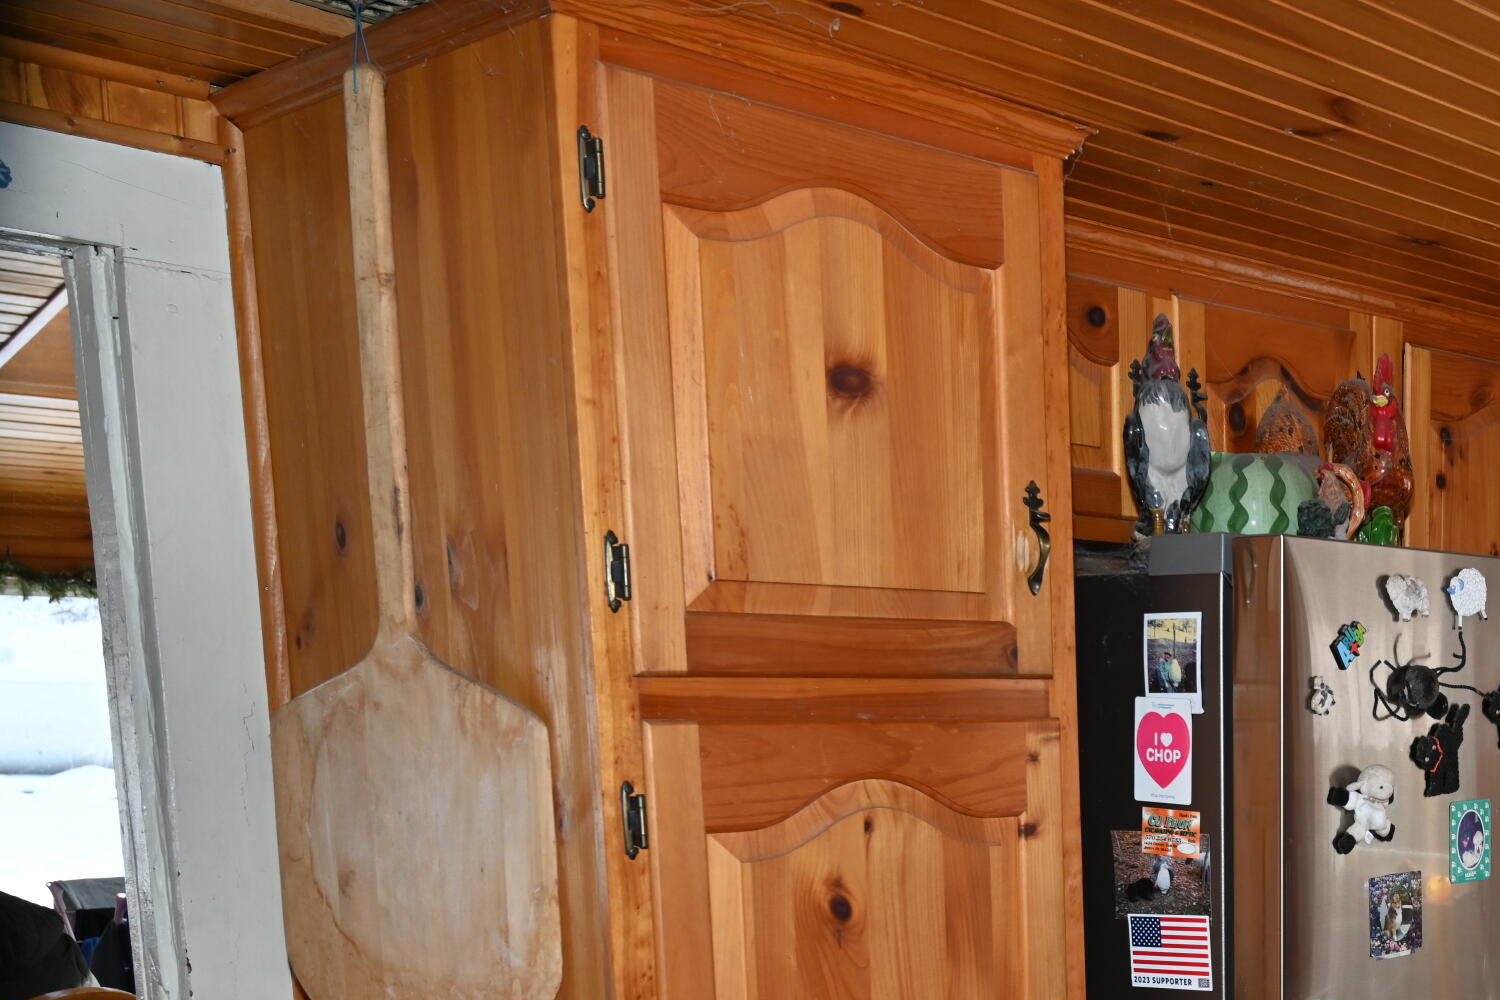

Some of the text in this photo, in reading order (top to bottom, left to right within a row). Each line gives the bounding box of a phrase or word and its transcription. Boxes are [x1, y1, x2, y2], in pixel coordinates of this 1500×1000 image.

[1154, 732, 1158, 746] I
[1146, 747, 1182, 764] CHOP
[1133, 976, 1150, 984] 2023
[1152, 976, 1192, 986] SUPPORTER
